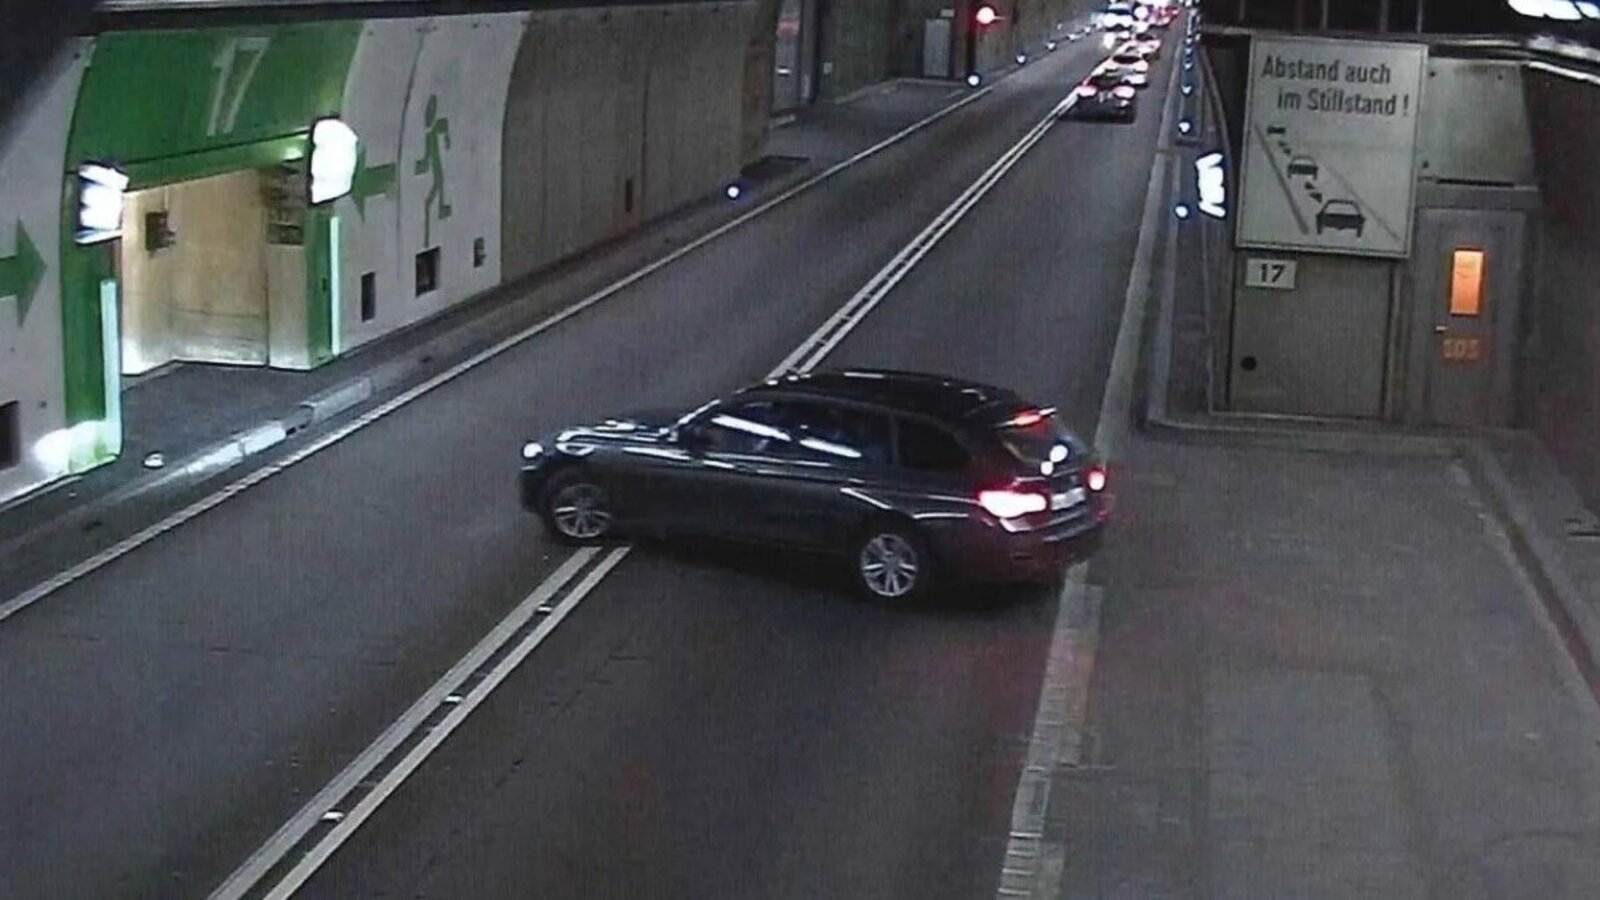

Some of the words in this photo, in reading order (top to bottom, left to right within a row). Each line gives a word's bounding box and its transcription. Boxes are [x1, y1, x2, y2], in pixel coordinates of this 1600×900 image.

[1261, 54, 1340, 82] Abstand
[1345, 63, 1391, 85] auch
[207, 36, 272, 137] 17
[1277, 87, 1300, 110] im
[1306, 88, 1396, 116] Stillstand
[1259, 264, 1286, 284] 17
[1443, 338, 1479, 359] SOS
